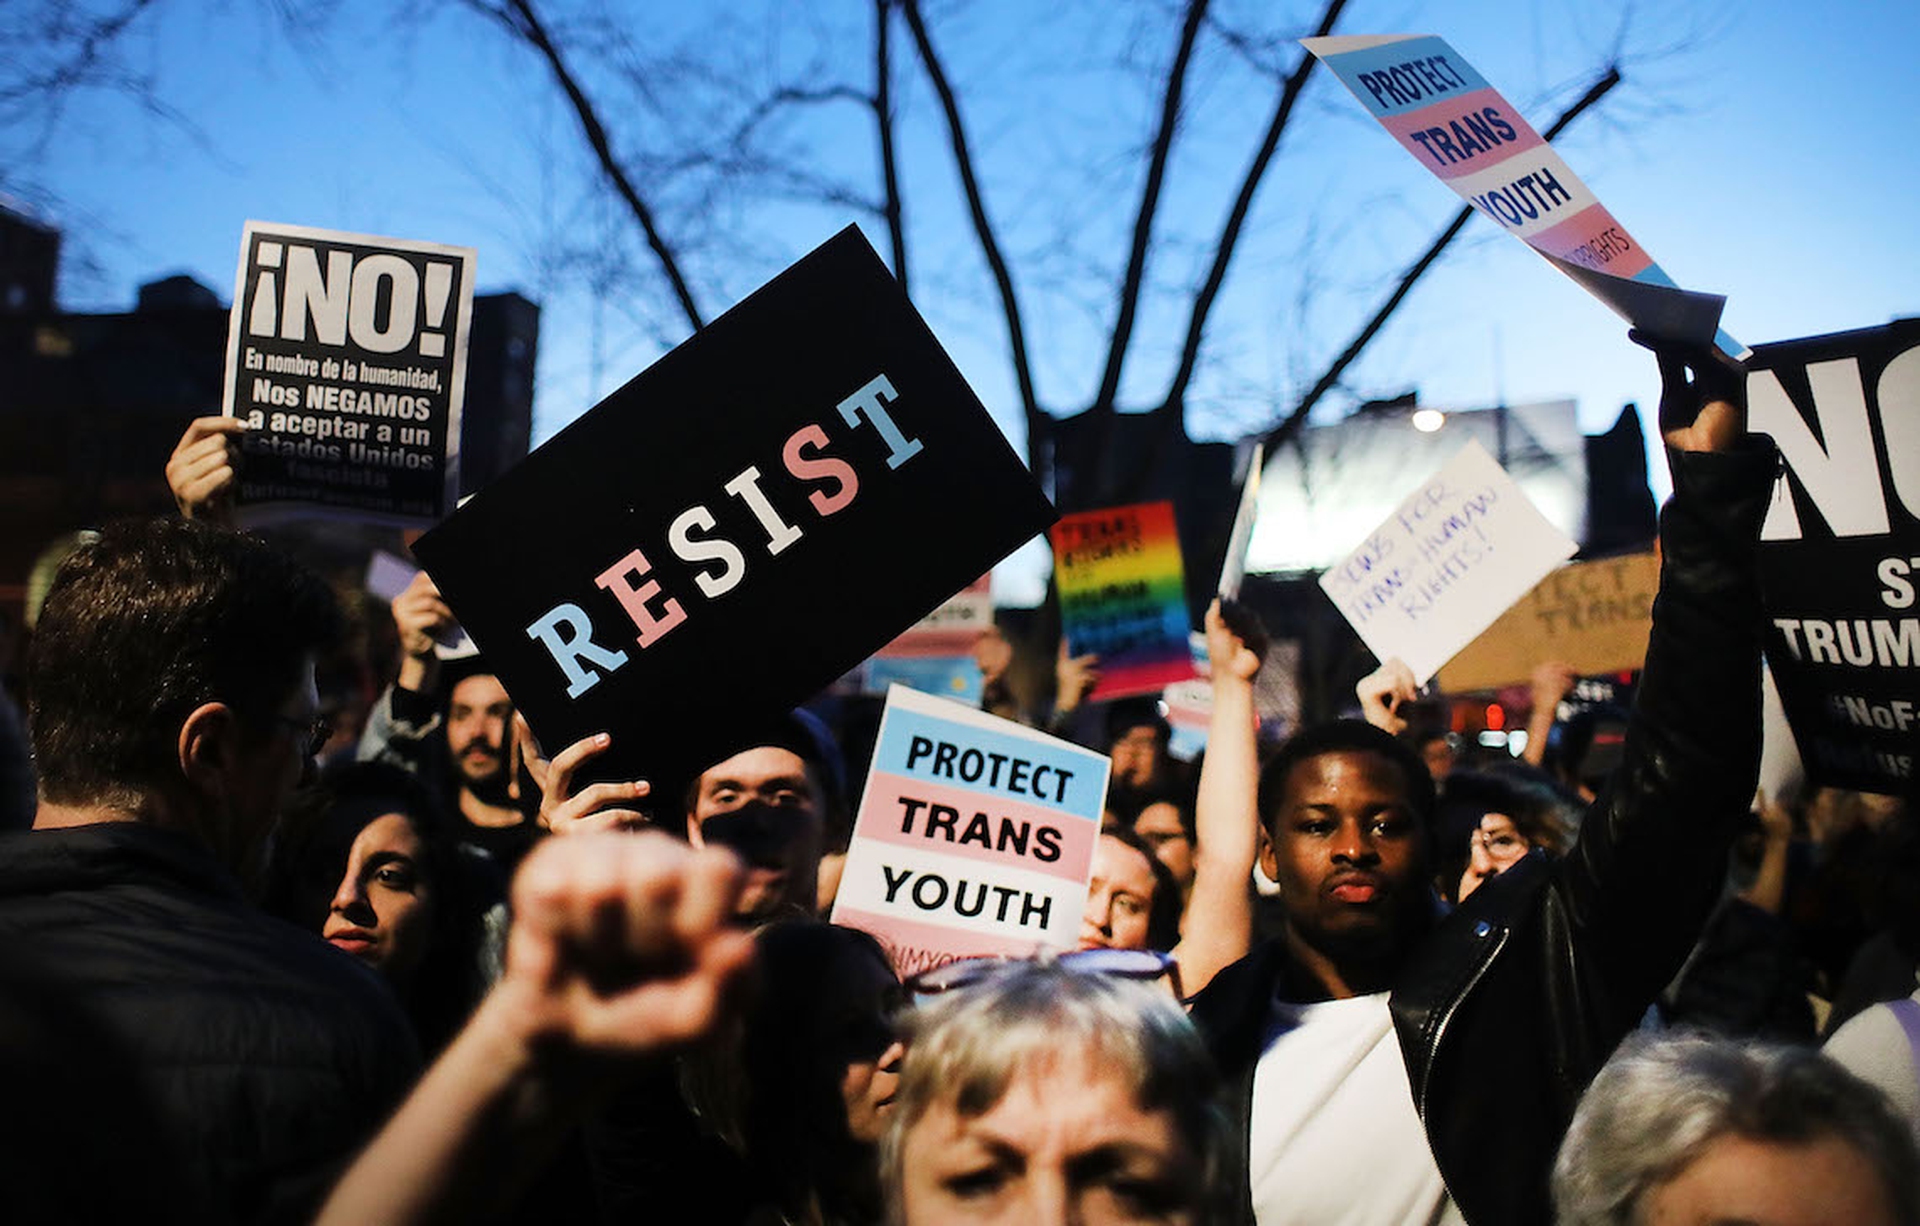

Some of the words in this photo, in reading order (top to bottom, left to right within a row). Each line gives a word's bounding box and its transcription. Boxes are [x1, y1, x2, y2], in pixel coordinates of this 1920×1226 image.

[1358, 55, 1467, 109] PROTECT
[1410, 107, 1517, 166] TRANS
[1471, 167, 1572, 228] YOUTH
[249, 241, 452, 357] ¡NO!
[245, 347, 263, 371] En
[265, 352, 317, 377] nombre
[321, 357, 340, 380] de
[342, 360, 356, 381] la
[360, 362, 442, 394] humanidad,
[253, 378, 300, 408] Nos
[306, 384, 431, 421] NEGAMOS
[249, 409, 264, 431] a
[270, 413, 370, 441] aceptar
[376, 424, 391, 443] a
[400, 428, 430, 446] un
[525, 373, 924, 699] RESIST
[905, 735, 1074, 803] PROTECT
[898, 796, 1063, 862] TRANS
[882, 865, 1053, 930] YOUTH
